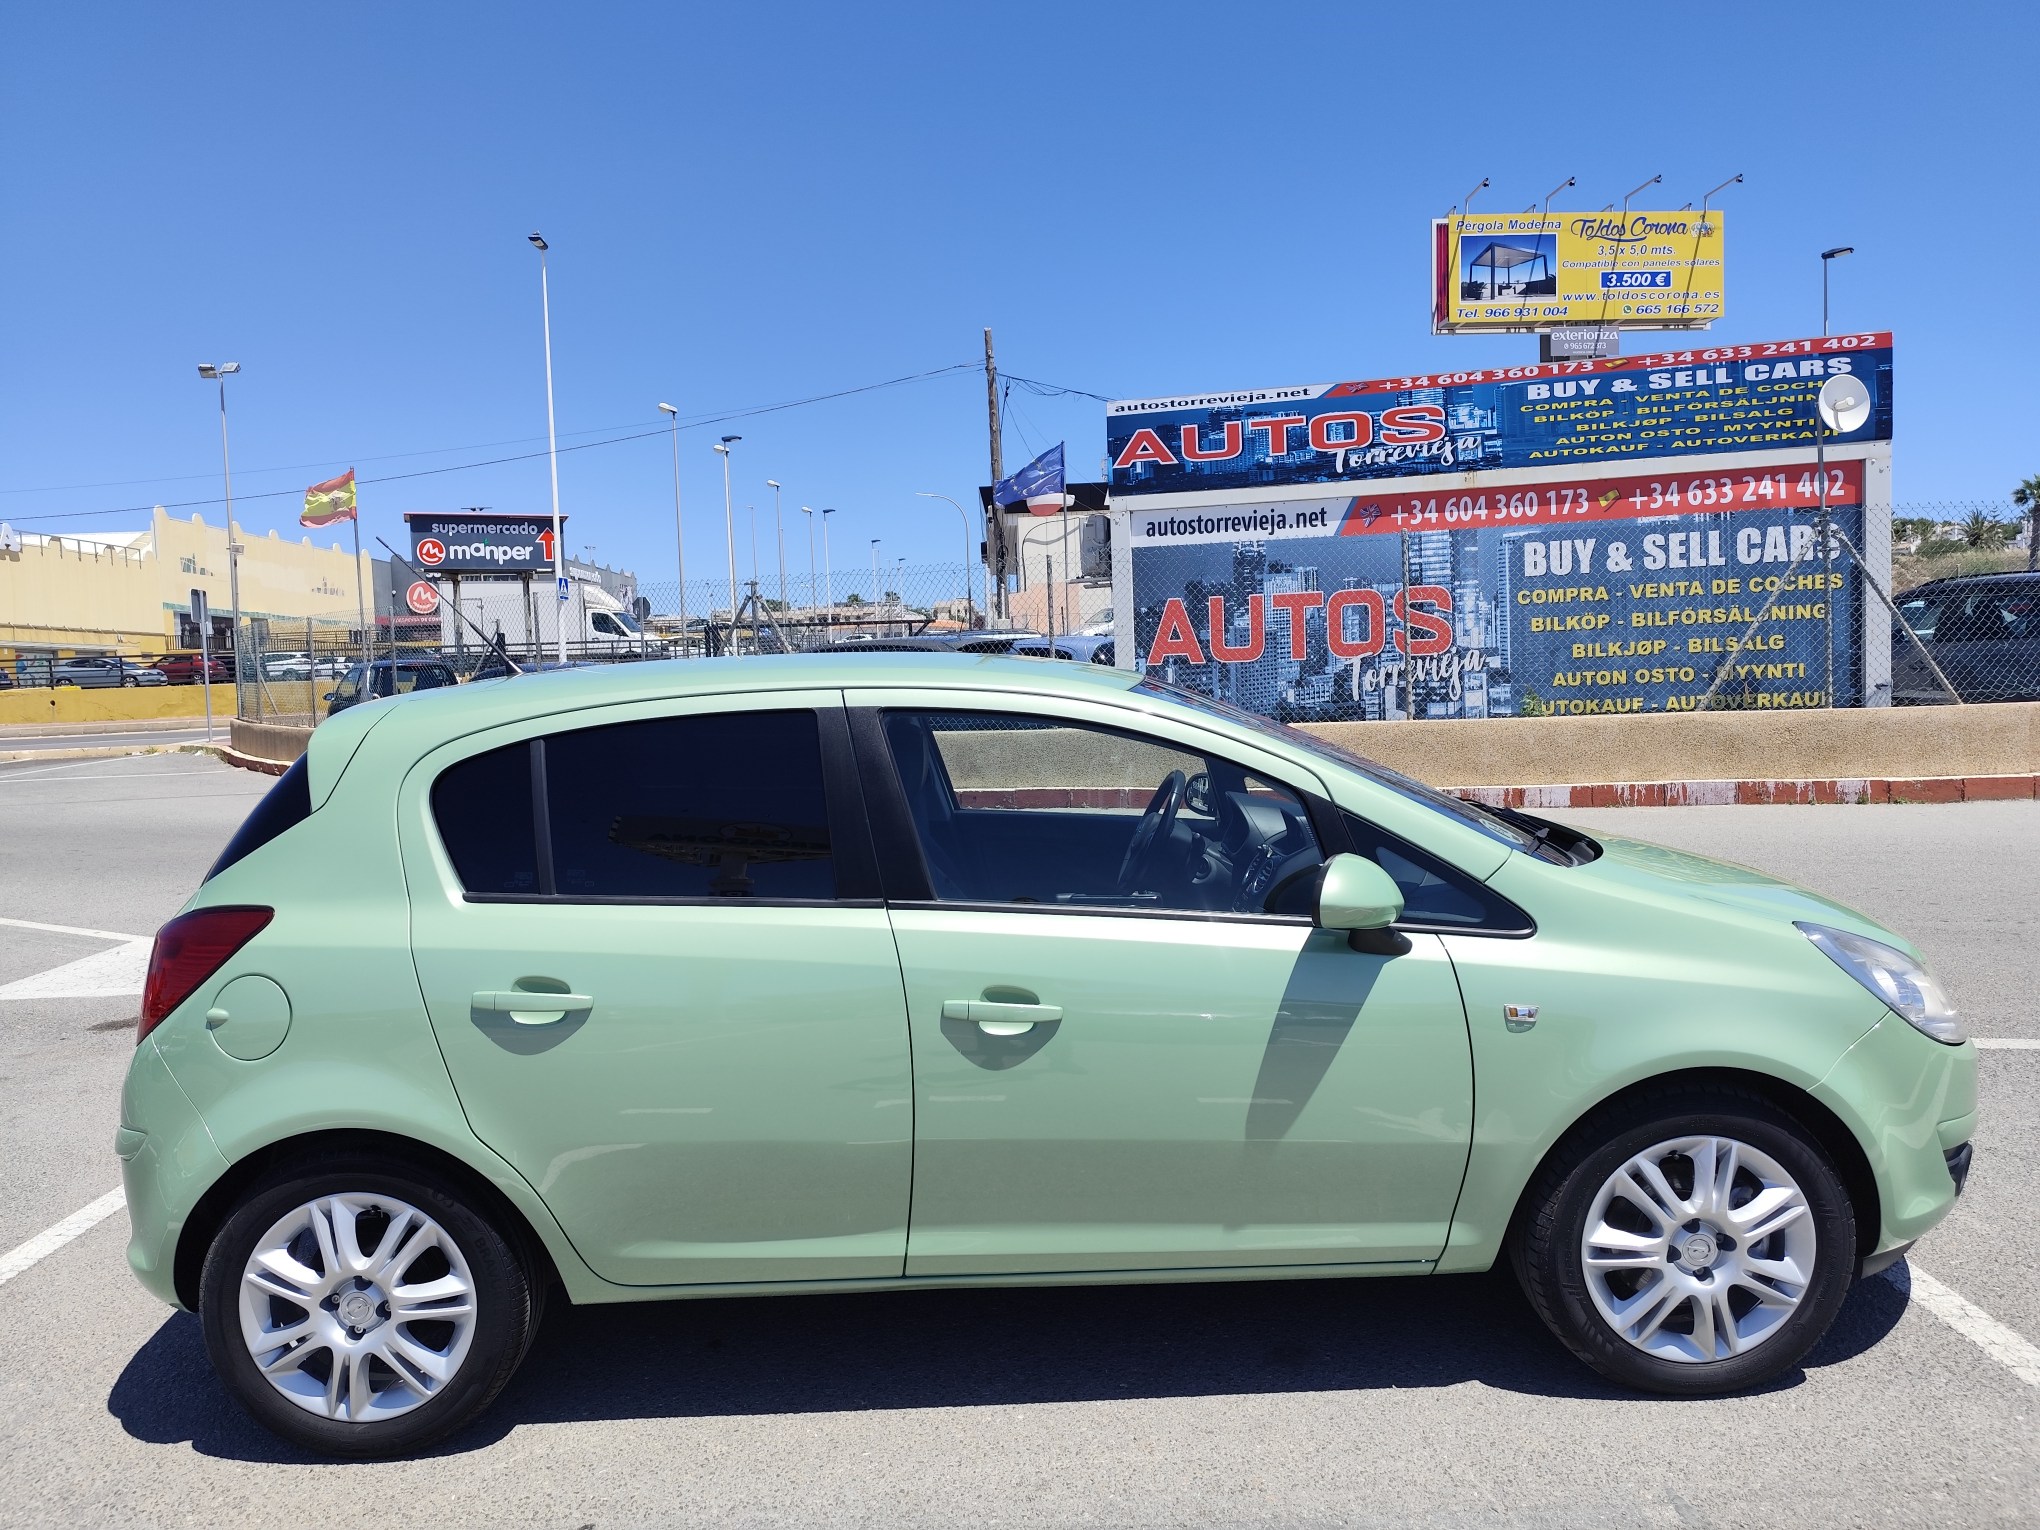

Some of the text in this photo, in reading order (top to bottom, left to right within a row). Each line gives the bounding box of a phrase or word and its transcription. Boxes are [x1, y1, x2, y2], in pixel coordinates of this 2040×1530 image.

[1456, 219, 1561, 232] Pérgola Moderna
[1571, 217, 1688, 242] Toldos Corona
[1598, 245, 1615, 255] 3,5
[1630, 244, 1647, 256] 5,0
[1651, 245, 1676, 254] mts.
[1562, 260, 1618, 269] Compatible
[1643, 260, 1681, 268] paneles
[1685, 259, 1720, 267] solares
[1607, 273, 1666, 286] 3.500 €
[1563, 291, 1720, 301] www.toldoscorona.es
[1457, 307, 1568, 318] Tel. 966 931 004
[1636, 304, 1719, 314] 665 166 572
[1551, 329, 1618, 340] exterioriza
[1378, 336, 1876, 390] +34 604 360 173 +34 633 241 402
[1527, 357, 1852, 400] BUY & SELL CARS
[1115, 387, 1311, 413] autostorrevieja.net
[1520, 398, 1612, 412] COMPRA
[1635, 391, 1708, 402] VENTA
[1719, 386, 1749, 396] DE
[1757, 380, 1826, 393] COCH
[1534, 410, 1615, 423] BILKÖP
[1636, 393, 1818, 415] BILFÖRSÄLJNIN
[1694, 408, 1794, 421] BILSALG
[1112, 405, 1446, 469] AUTOS
[1556, 432, 1641, 445] AUTON
[1649, 427, 1701, 438] OSTO
[1723, 418, 1815, 433] MYYNTI
[1327, 436, 1482, 474] Torrevieja
[1529, 443, 1649, 459] AUTOKAUF
[1391, 469, 1845, 526] +34 604 360 173 +34 633 241 402
[431, 522, 538, 536] supermercado
[1146, 507, 1327, 537] autostorrevieja.net
[449, 539, 534, 565] manper
[1524, 523, 1841, 576] BUY & SELL CARS
[1517, 586, 1609, 605] COMPRA
[1630, 582, 1704, 599] VENTA
[1712, 578, 1741, 595] DE
[1748, 573, 1843, 593] COCHES
[1147, 585, 1453, 666] AUTOS
[1531, 612, 1610, 632] BILKÖP
[1344, 646, 1488, 702] Torrevieja
[1553, 670, 1627, 687] AUTON
[1635, 667, 1695, 684] OSTO
[1542, 698, 1644, 716] UTOKAUF
